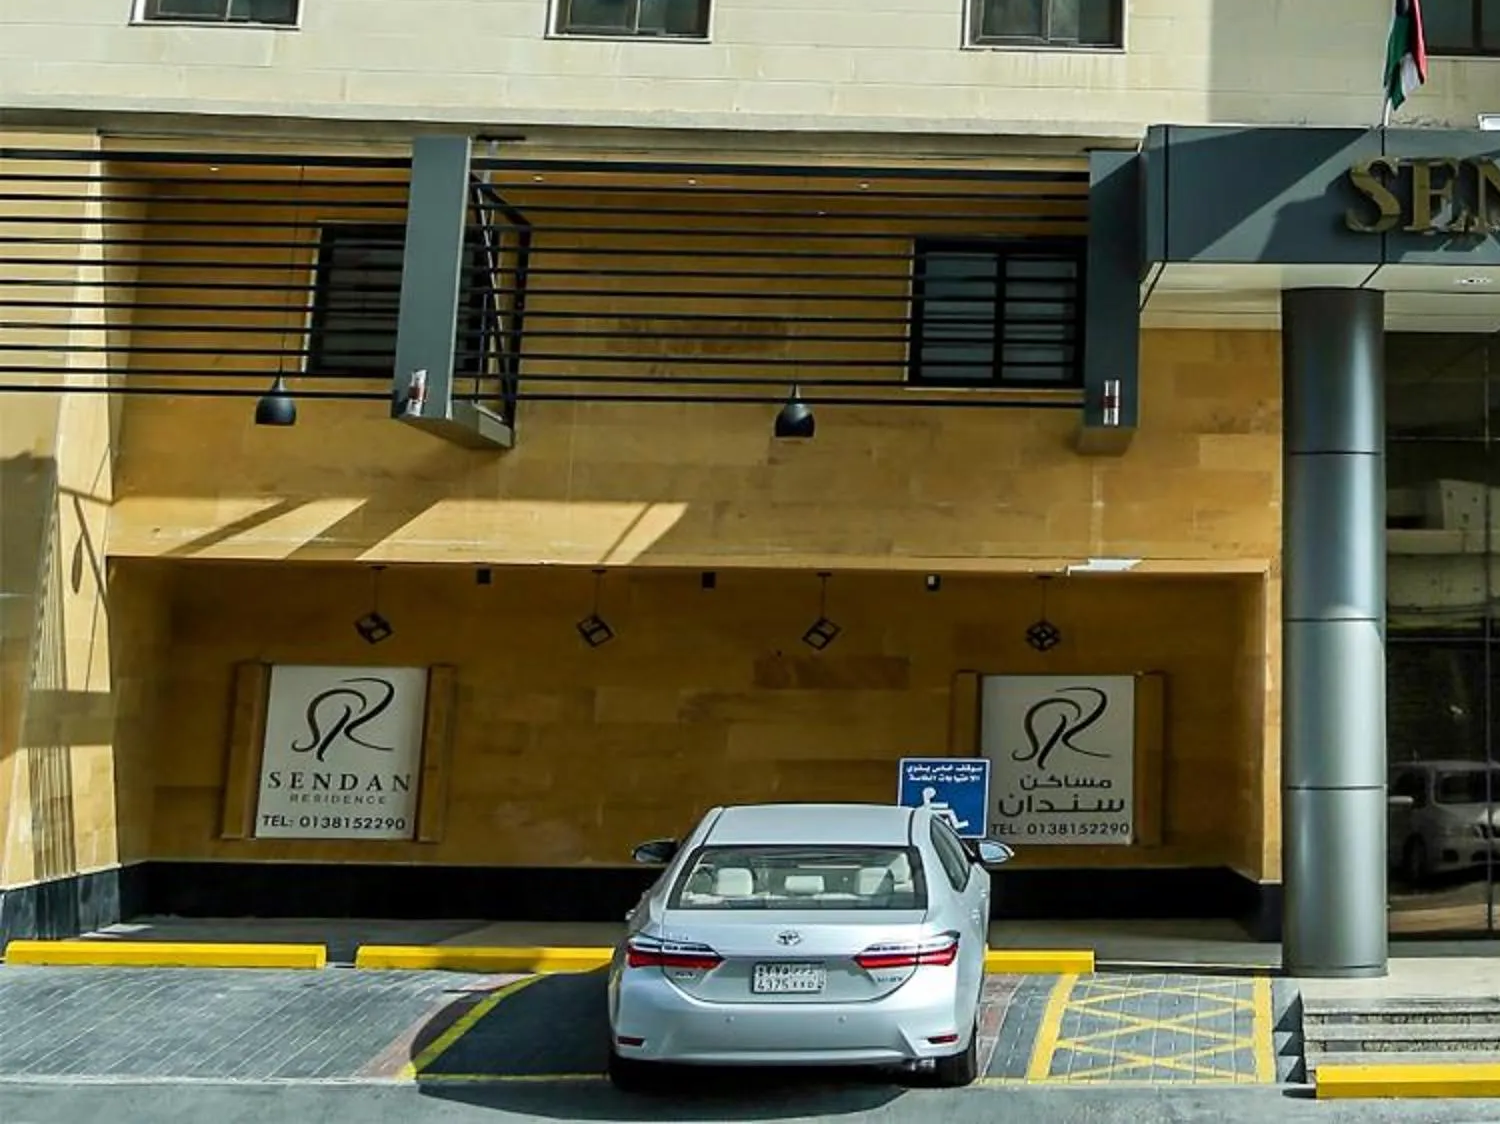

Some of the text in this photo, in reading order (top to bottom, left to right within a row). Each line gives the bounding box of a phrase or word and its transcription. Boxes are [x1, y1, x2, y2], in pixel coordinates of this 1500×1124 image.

[268, 771, 410, 792] SENDAN
[1020, 774, 1112, 791] مساكن
[290, 793, 387, 805] RESIDENCE
[998, 794, 1125, 818] سندان
[262, 814, 406, 831] TEL: 0138152290
[1027, 823, 1130, 836] 0138152290
